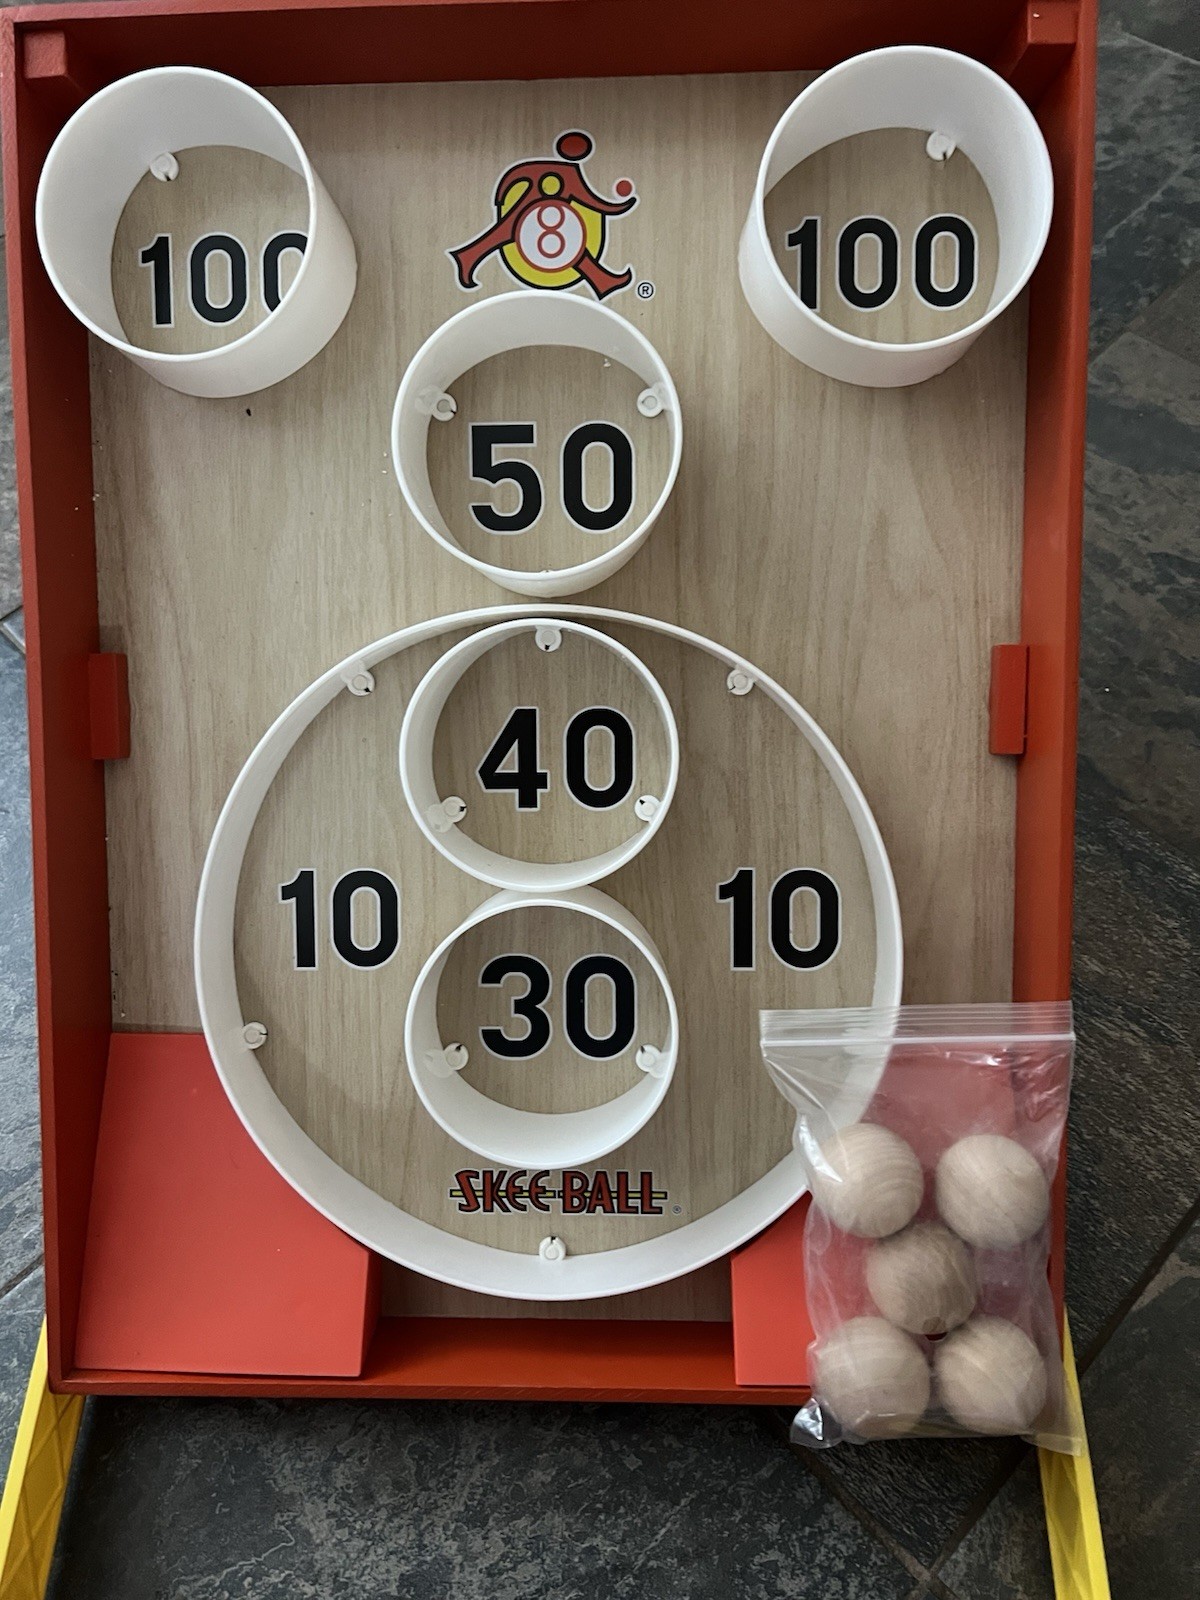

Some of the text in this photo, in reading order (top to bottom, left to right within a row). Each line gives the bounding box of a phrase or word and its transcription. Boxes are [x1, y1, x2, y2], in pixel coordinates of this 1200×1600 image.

[786, 215, 976, 310] 100
[469, 422, 634, 532] 50
[478, 707, 634, 810] 40
[280, 869, 399, 969] 10
[717, 868, 840, 969] 10
[480, 954, 636, 1058] 30
[453, 1169, 664, 1215] SKEE BALL
